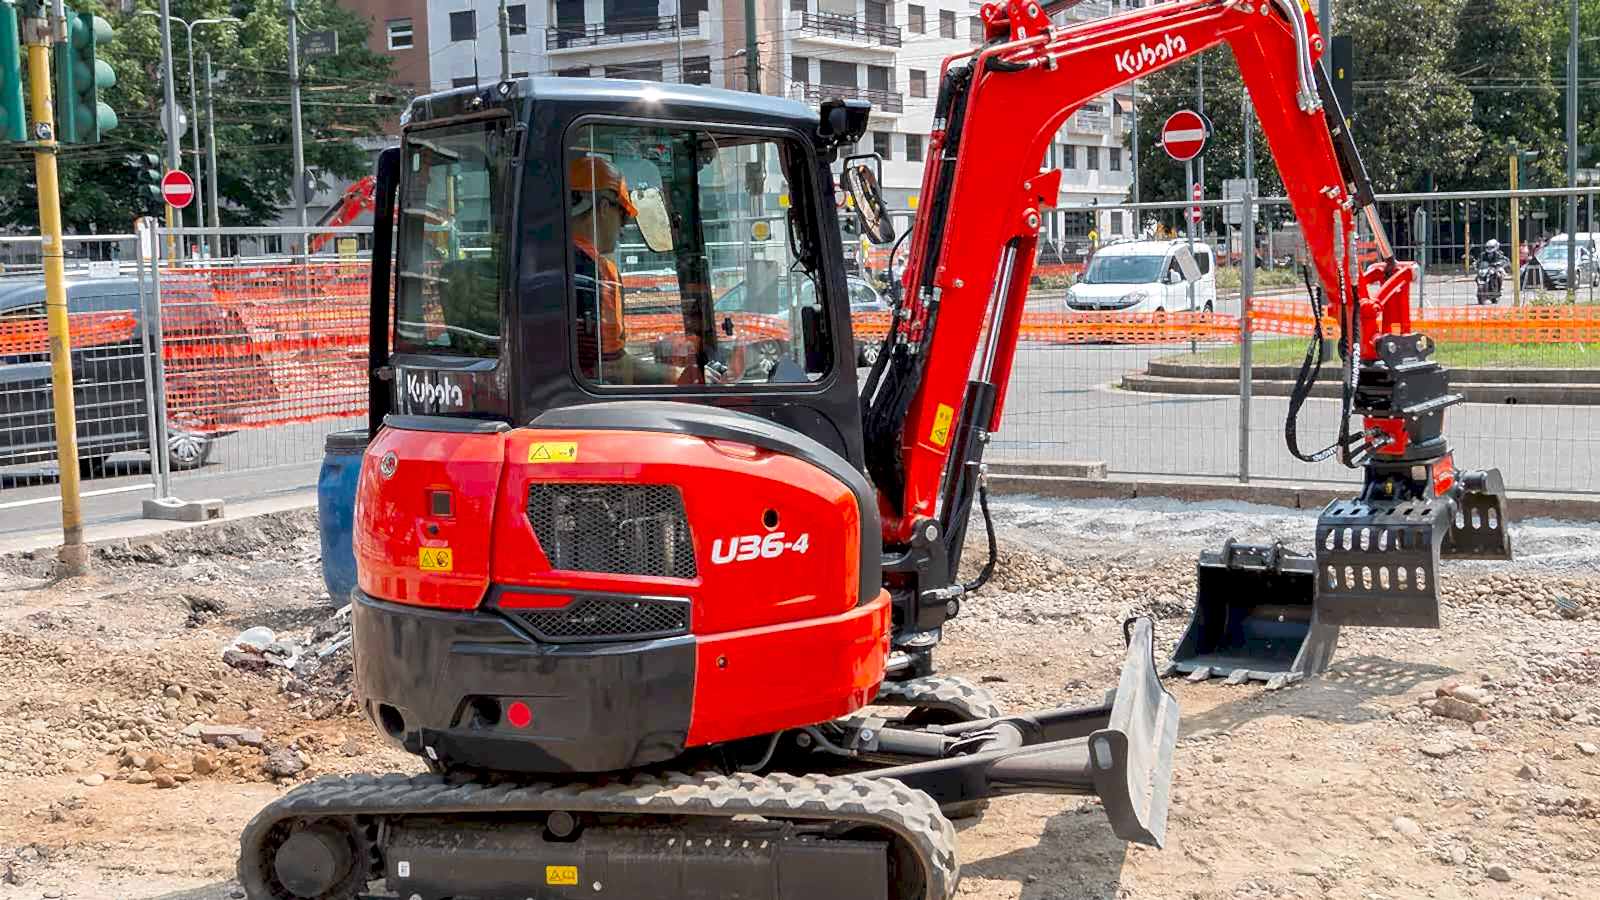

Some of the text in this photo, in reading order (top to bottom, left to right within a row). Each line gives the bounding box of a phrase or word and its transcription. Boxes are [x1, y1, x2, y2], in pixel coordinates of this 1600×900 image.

[1115, 34, 1186, 74] Kubota
[407, 374, 463, 406] Kubota
[711, 532, 809, 564] U36-4
